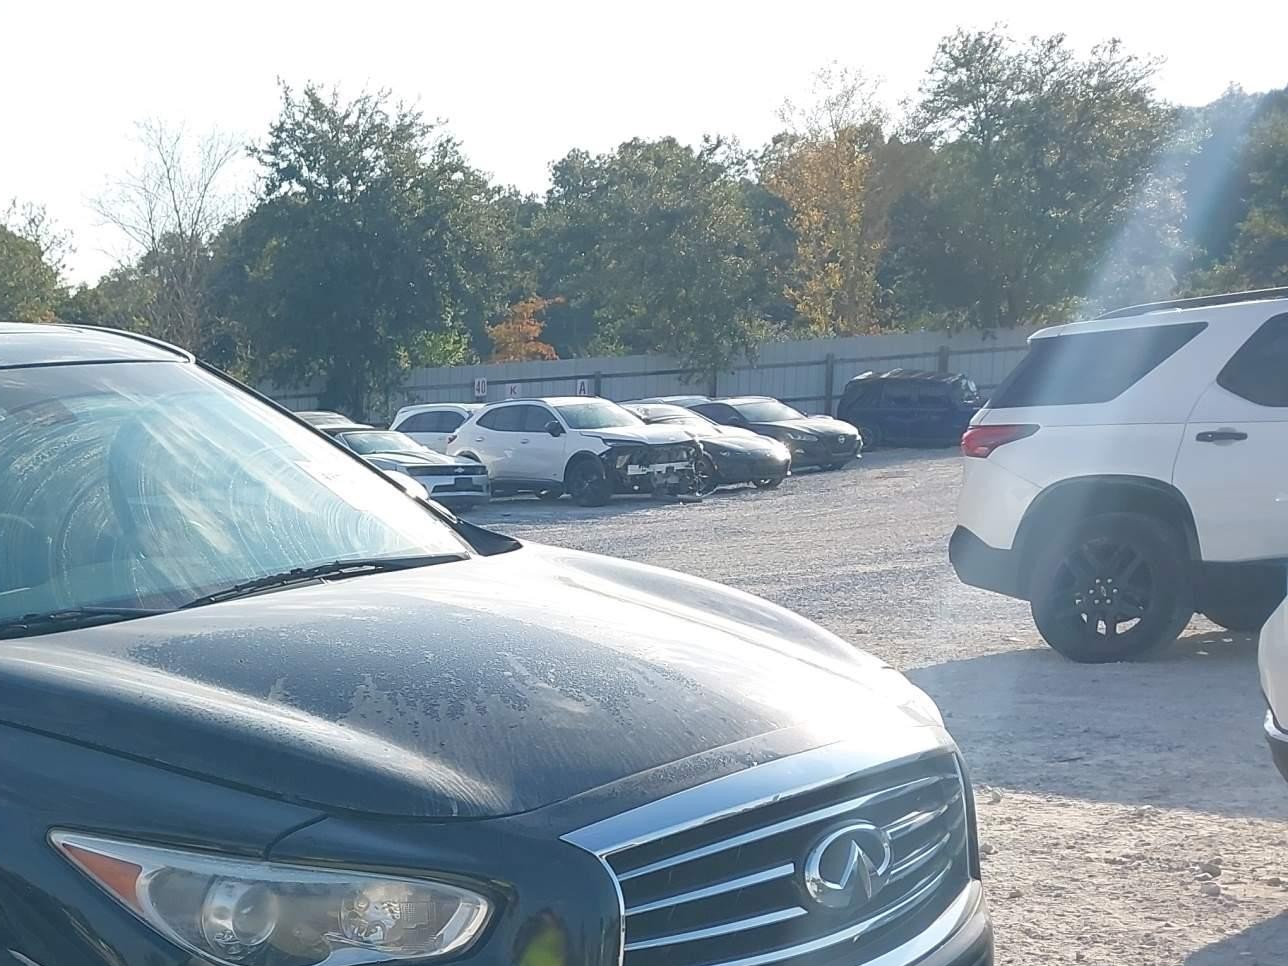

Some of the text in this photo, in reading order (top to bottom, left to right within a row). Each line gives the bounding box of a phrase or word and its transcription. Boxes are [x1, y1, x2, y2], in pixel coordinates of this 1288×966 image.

[475, 379, 486, 394] 40
[509, 385, 517, 395] K
[578, 380, 586, 395] A
